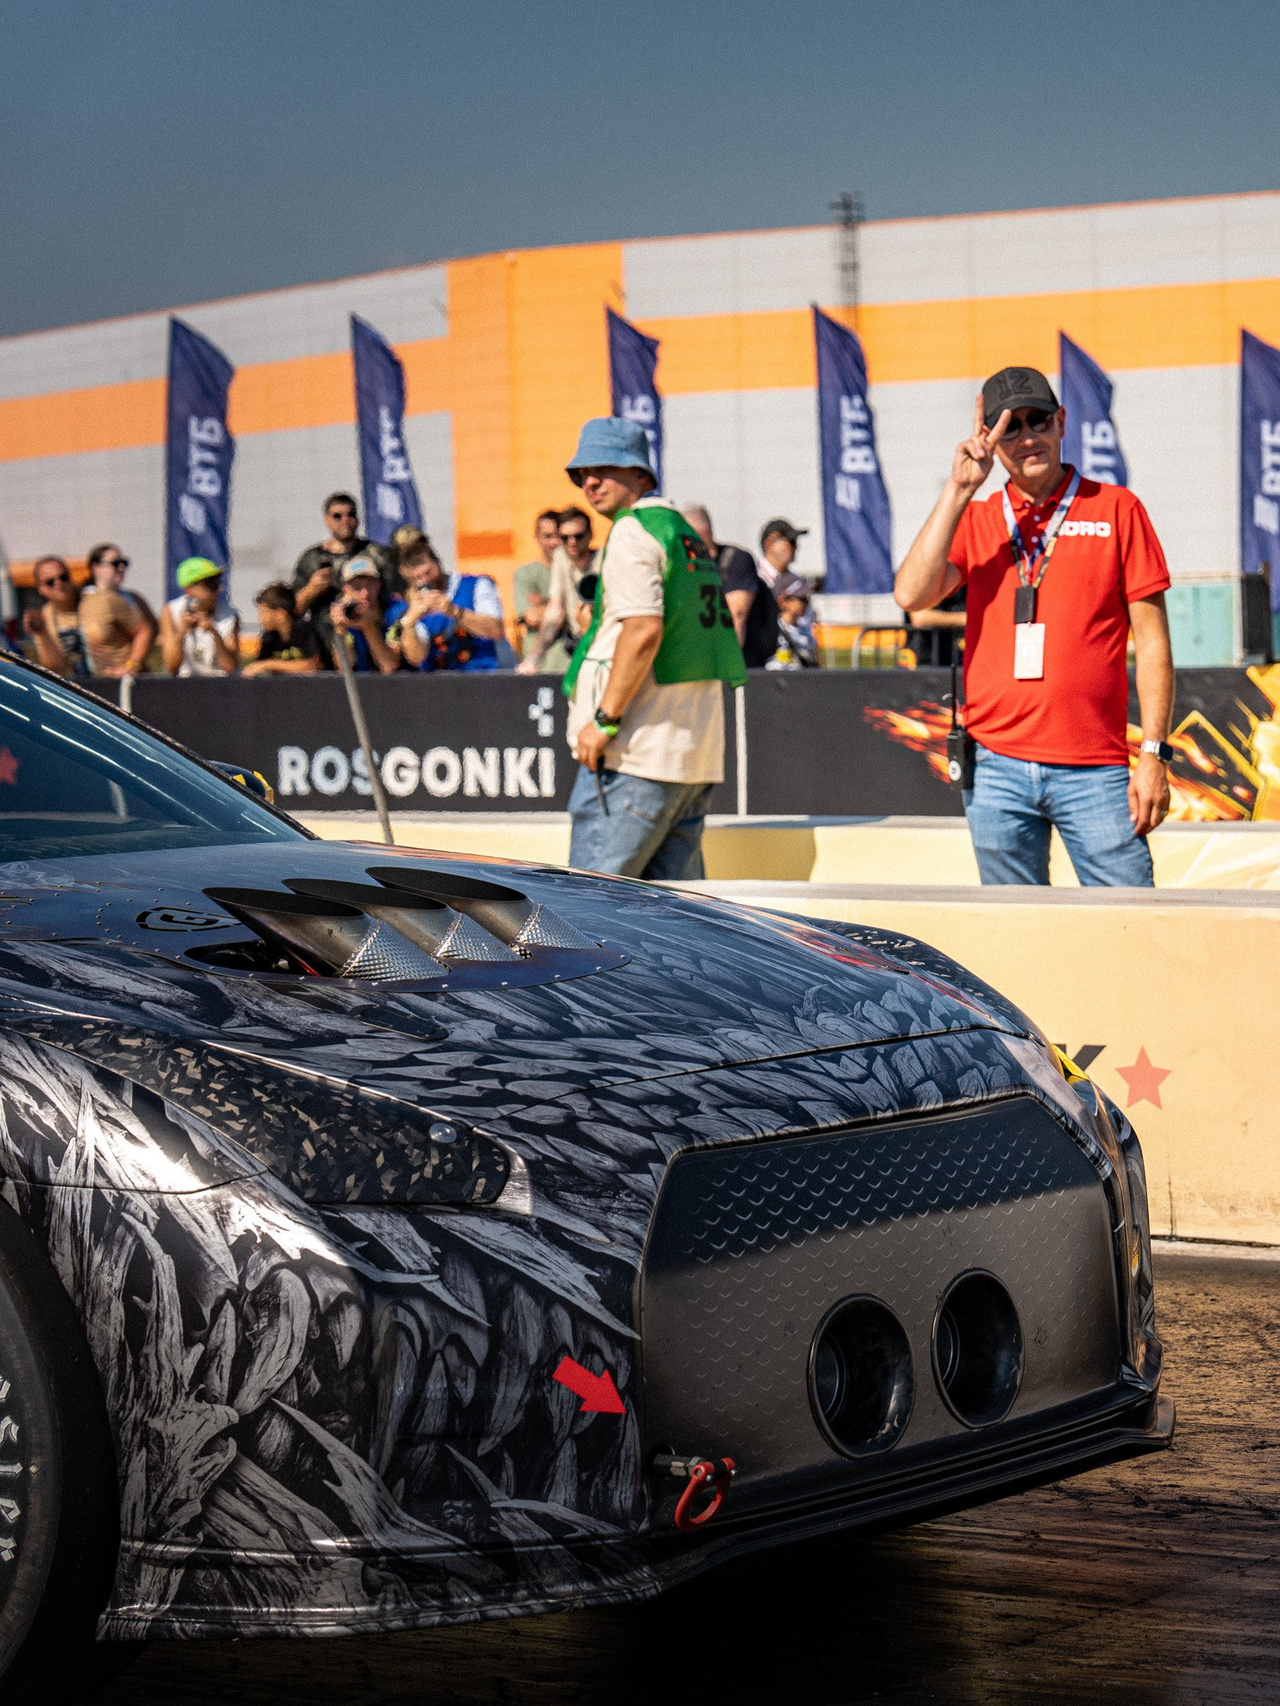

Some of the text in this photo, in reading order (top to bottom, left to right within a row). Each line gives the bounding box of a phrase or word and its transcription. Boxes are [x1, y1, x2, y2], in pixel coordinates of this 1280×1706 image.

[188, 415, 225, 498] ВТБ
[1058, 520, 1112, 538] DRC
[277, 745, 557, 798] ROSGONKI
